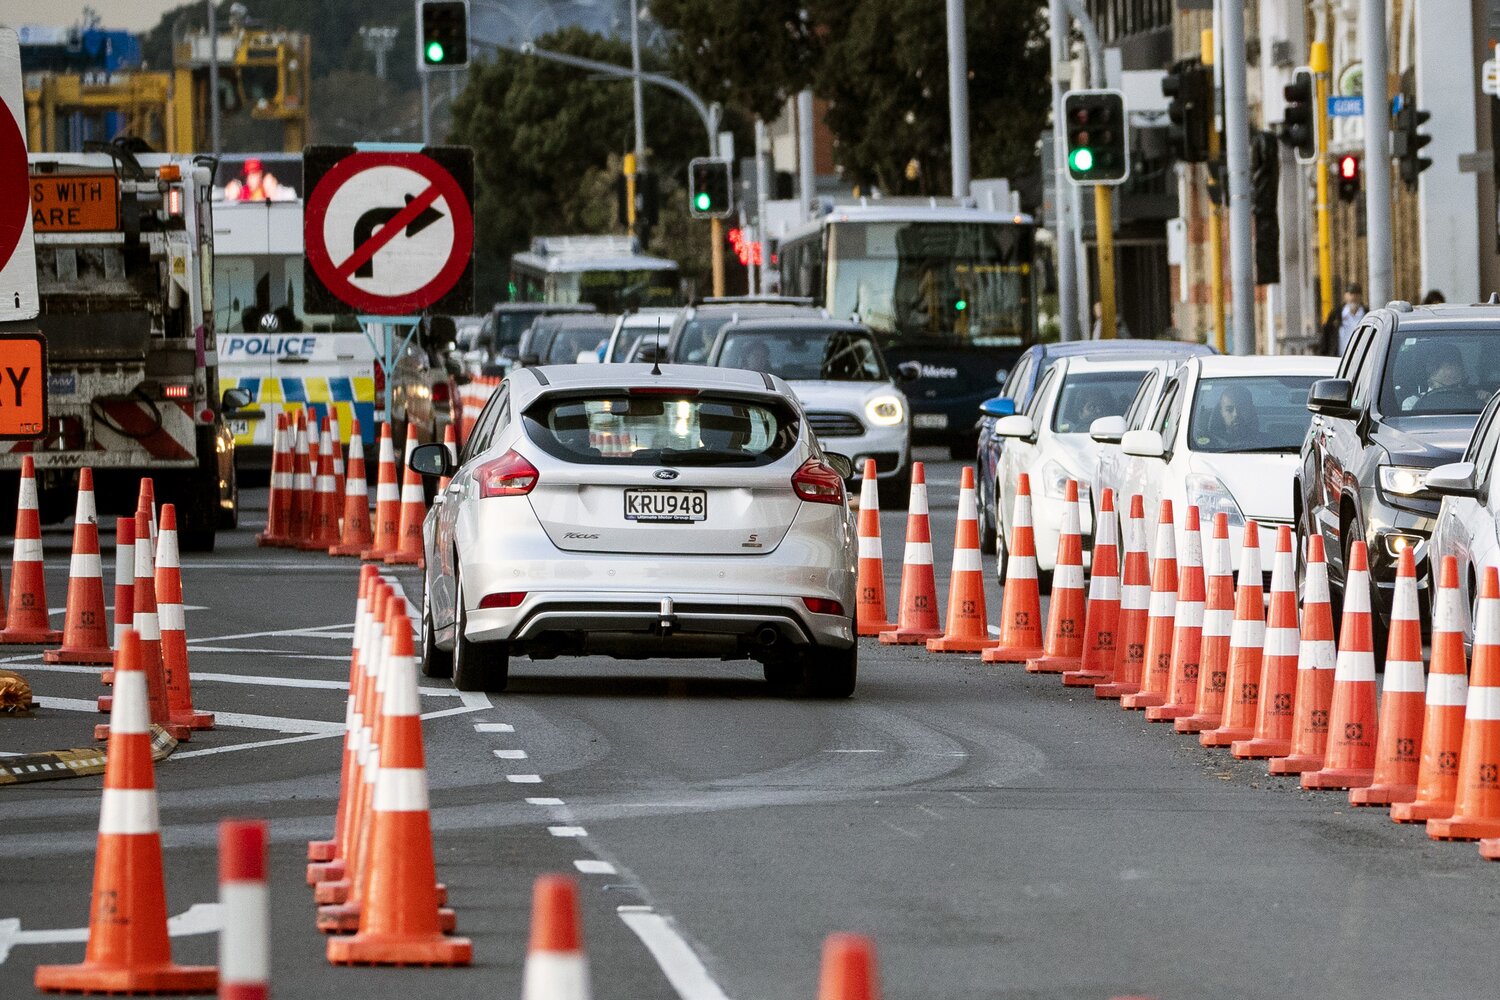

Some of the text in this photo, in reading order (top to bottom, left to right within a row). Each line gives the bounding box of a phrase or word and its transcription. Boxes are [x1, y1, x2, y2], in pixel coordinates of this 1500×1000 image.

[56, 183, 102, 202] WITH
[228, 338, 316, 355] POLICE
[922, 365, 957, 378] Metro
[658, 471, 675, 479] Ford
[628, 495, 703, 514] KRU948
